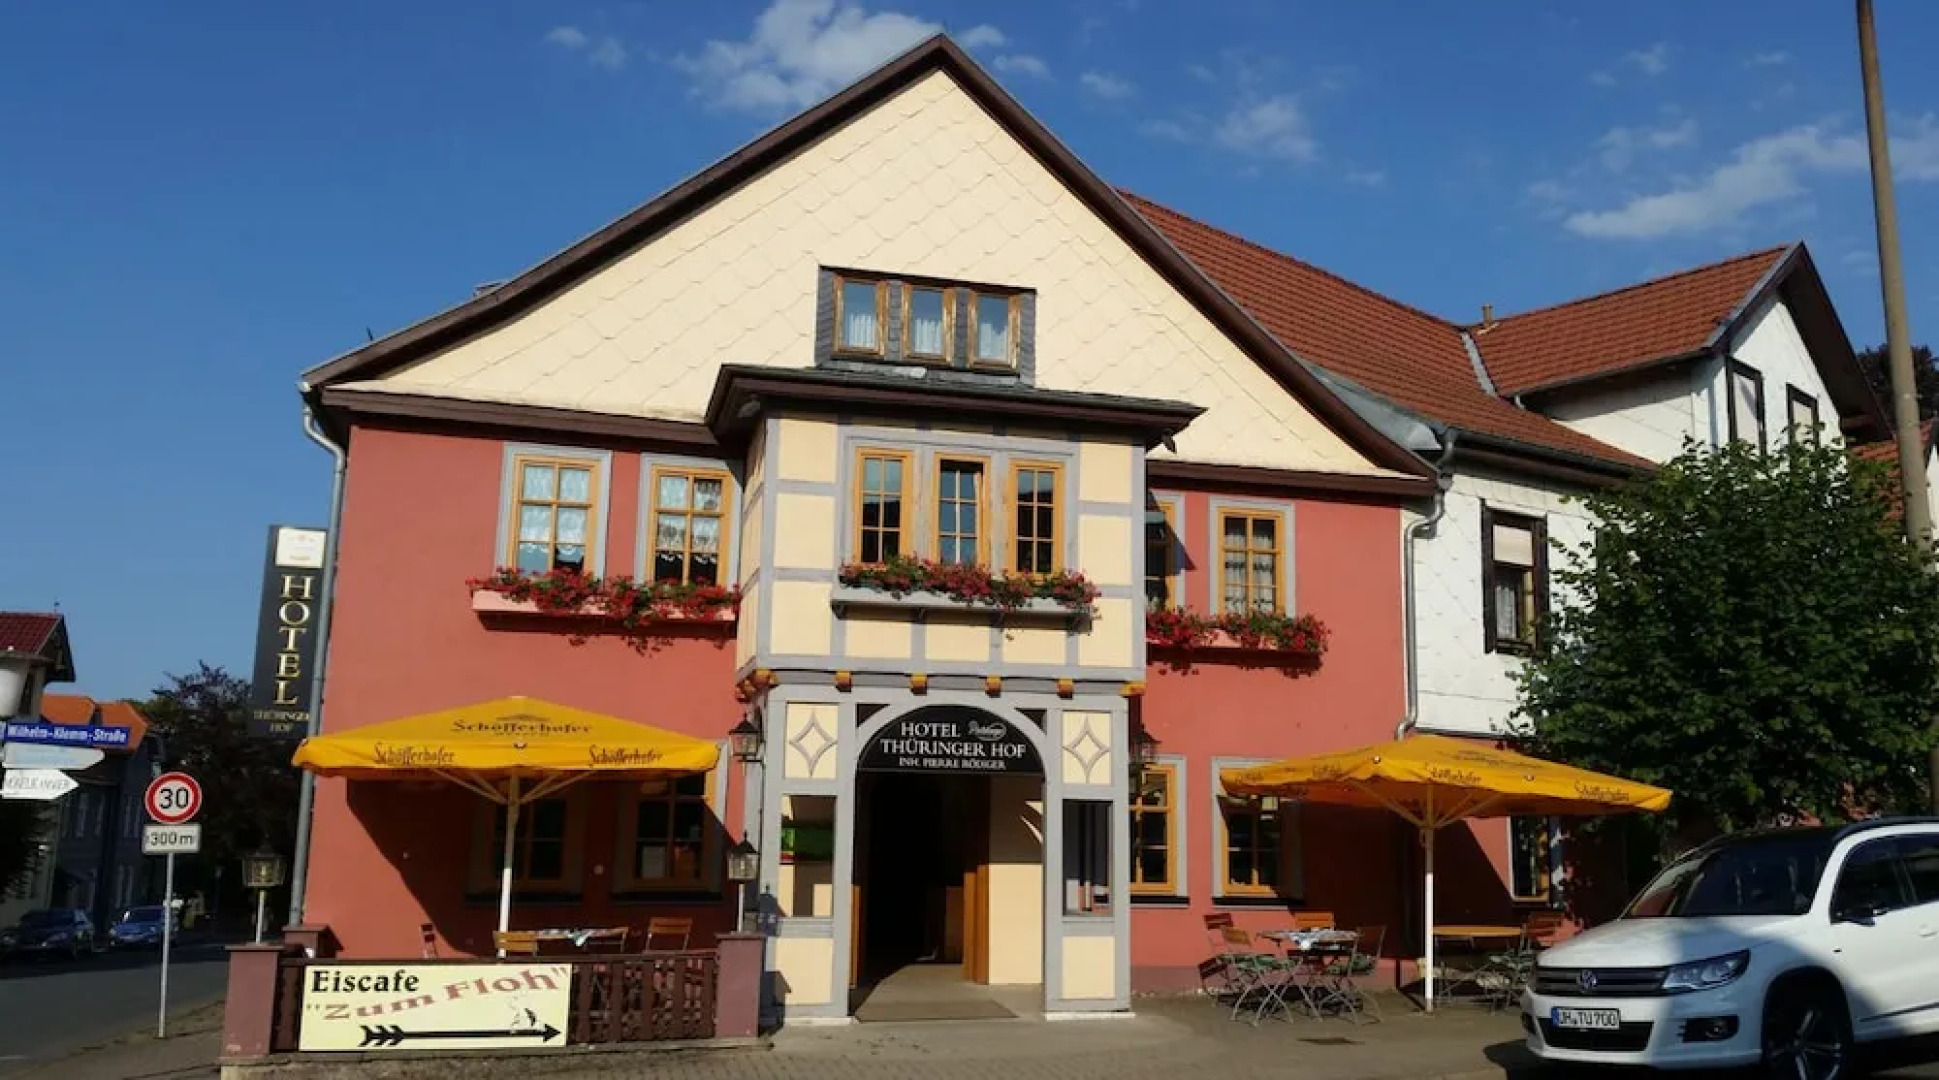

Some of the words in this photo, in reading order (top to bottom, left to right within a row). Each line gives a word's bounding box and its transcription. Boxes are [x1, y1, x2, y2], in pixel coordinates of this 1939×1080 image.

[274, 574, 314, 704] HOTEL
[901, 722, 961, 738] HOTEL
[880, 738, 986, 757] THÜRINGER
[992, 743, 1027, 758] HOF
[159, 787, 189, 809] 30
[311, 970, 421, 994] Eiscafe
